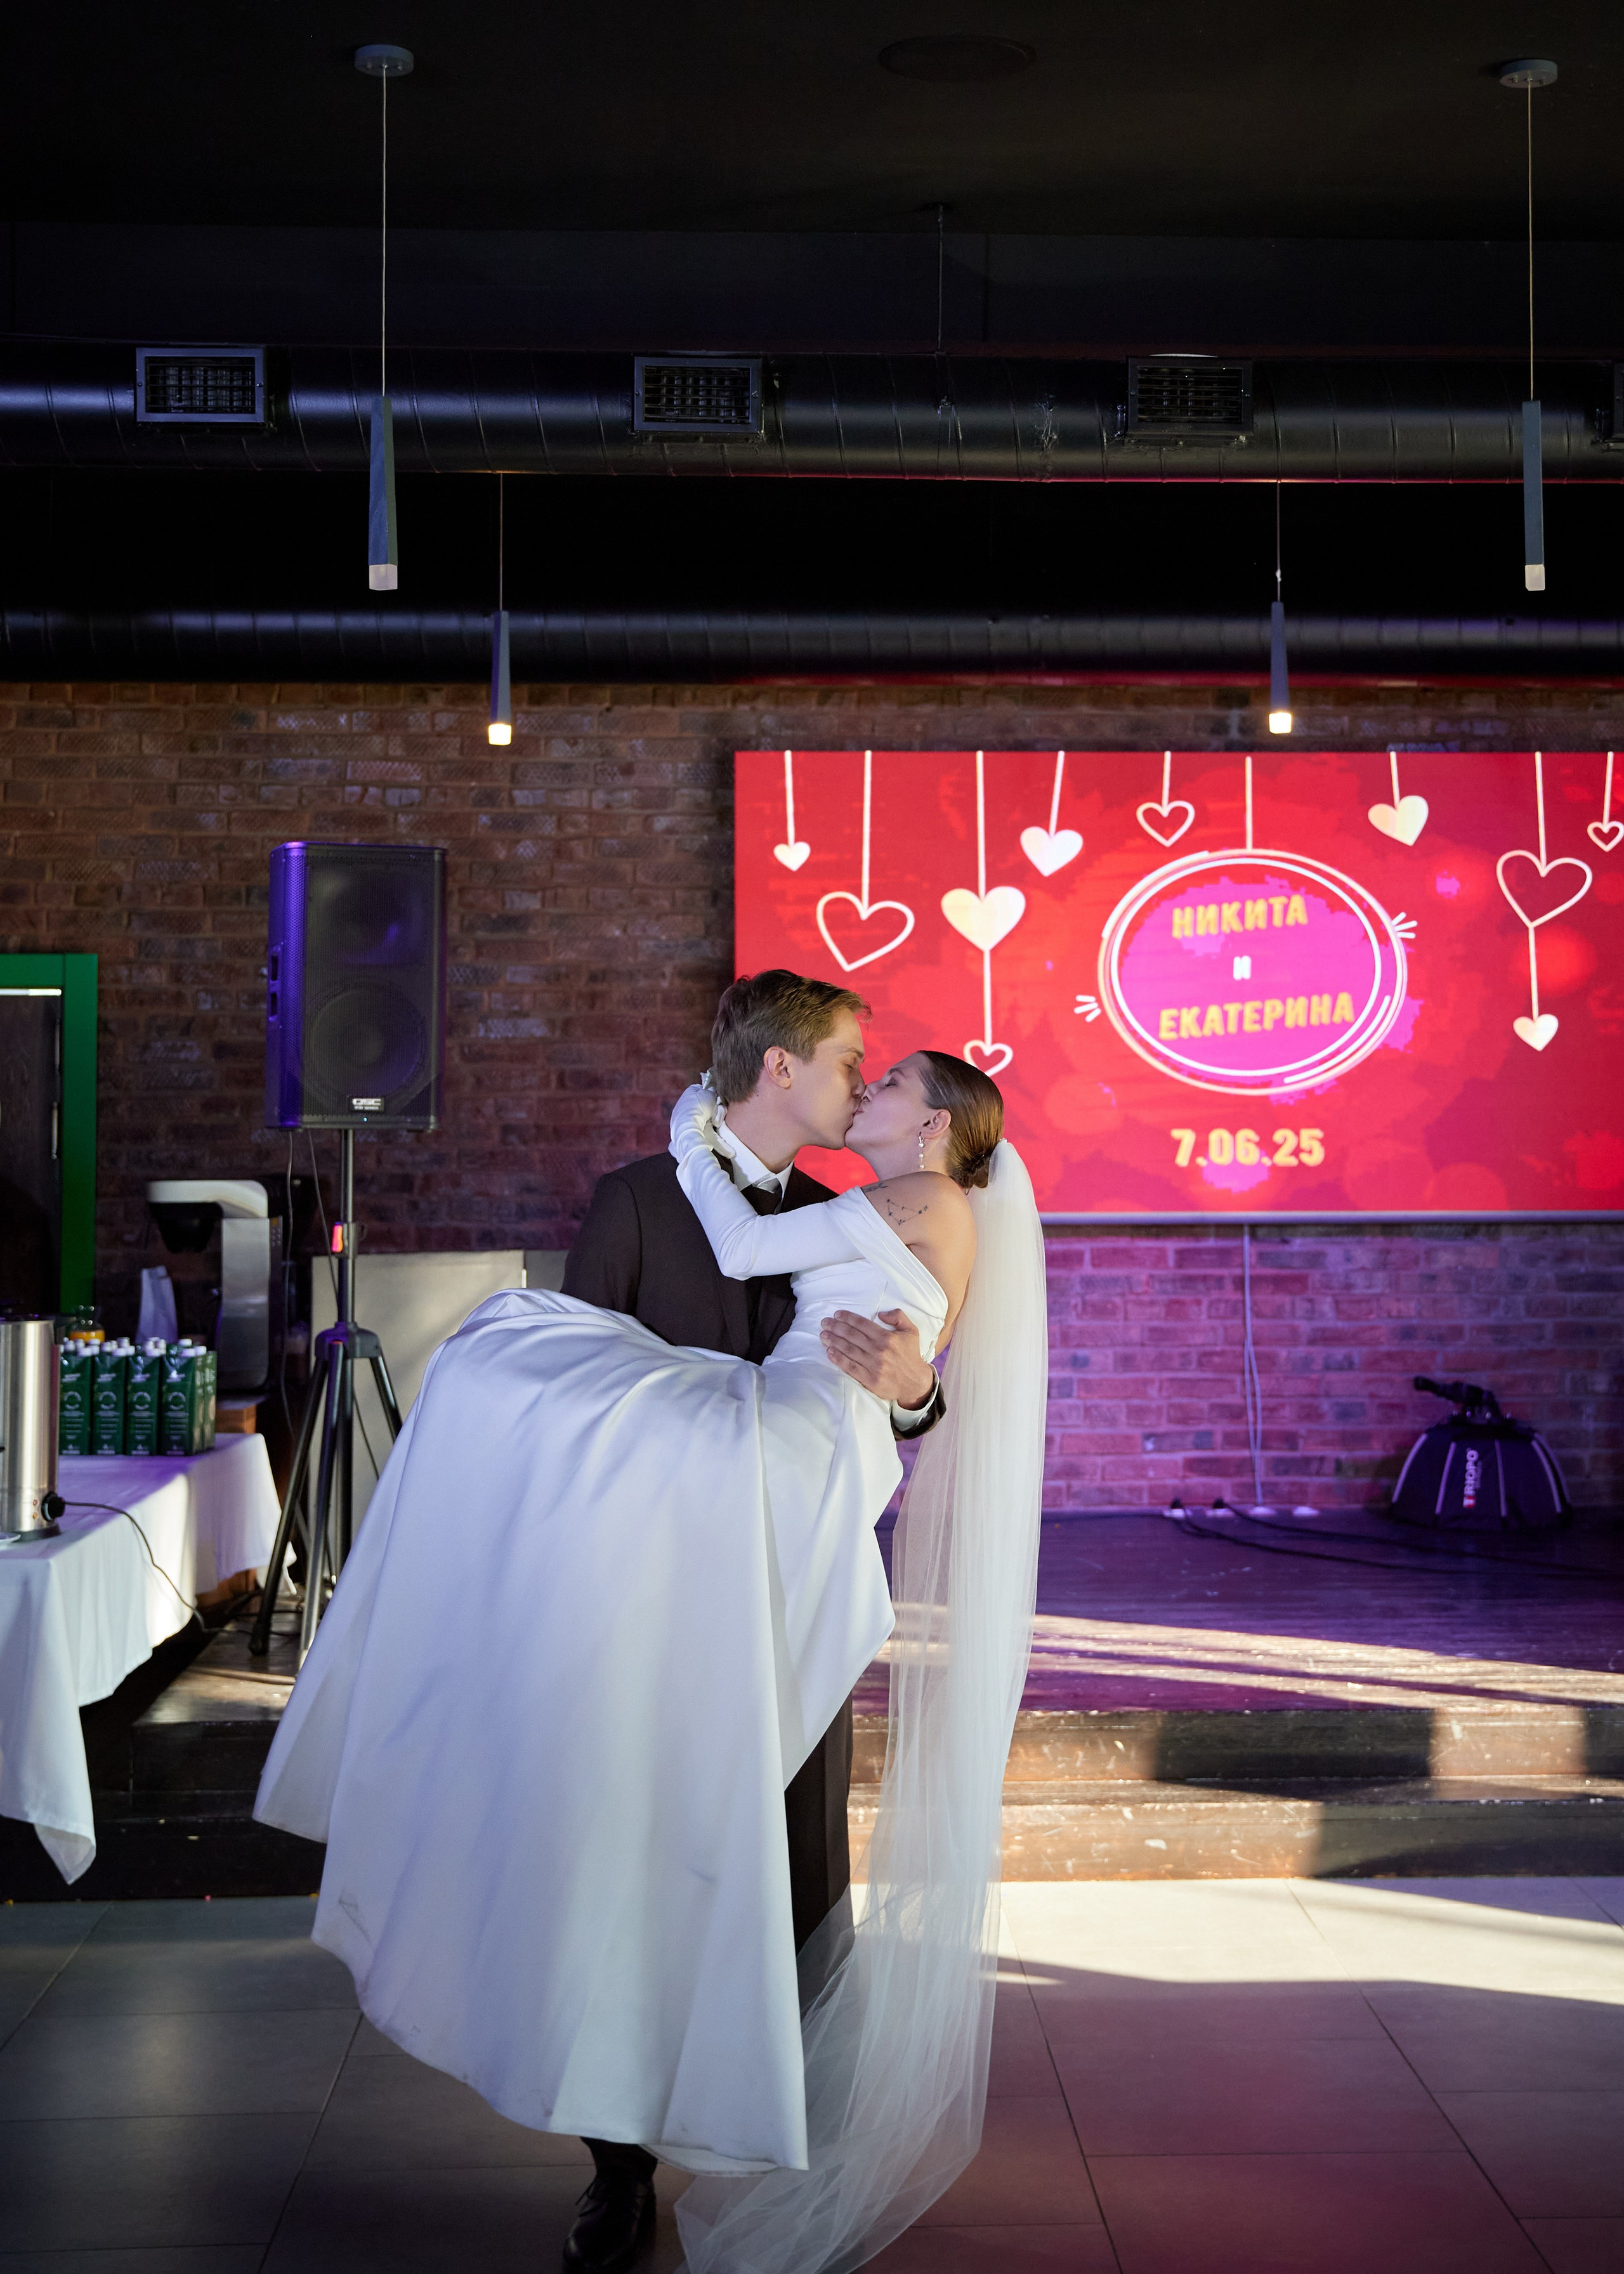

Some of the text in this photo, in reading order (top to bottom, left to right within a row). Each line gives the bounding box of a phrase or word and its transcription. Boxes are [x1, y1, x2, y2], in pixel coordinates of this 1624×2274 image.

[1172, 894, 1307, 938] НИКИТА
[1158, 992, 1355, 1040] ЕКАТЕРИНА
[1170, 1128, 1325, 1167] 7.06.25
[1463, 1449, 1479, 1508] TRIOPO
